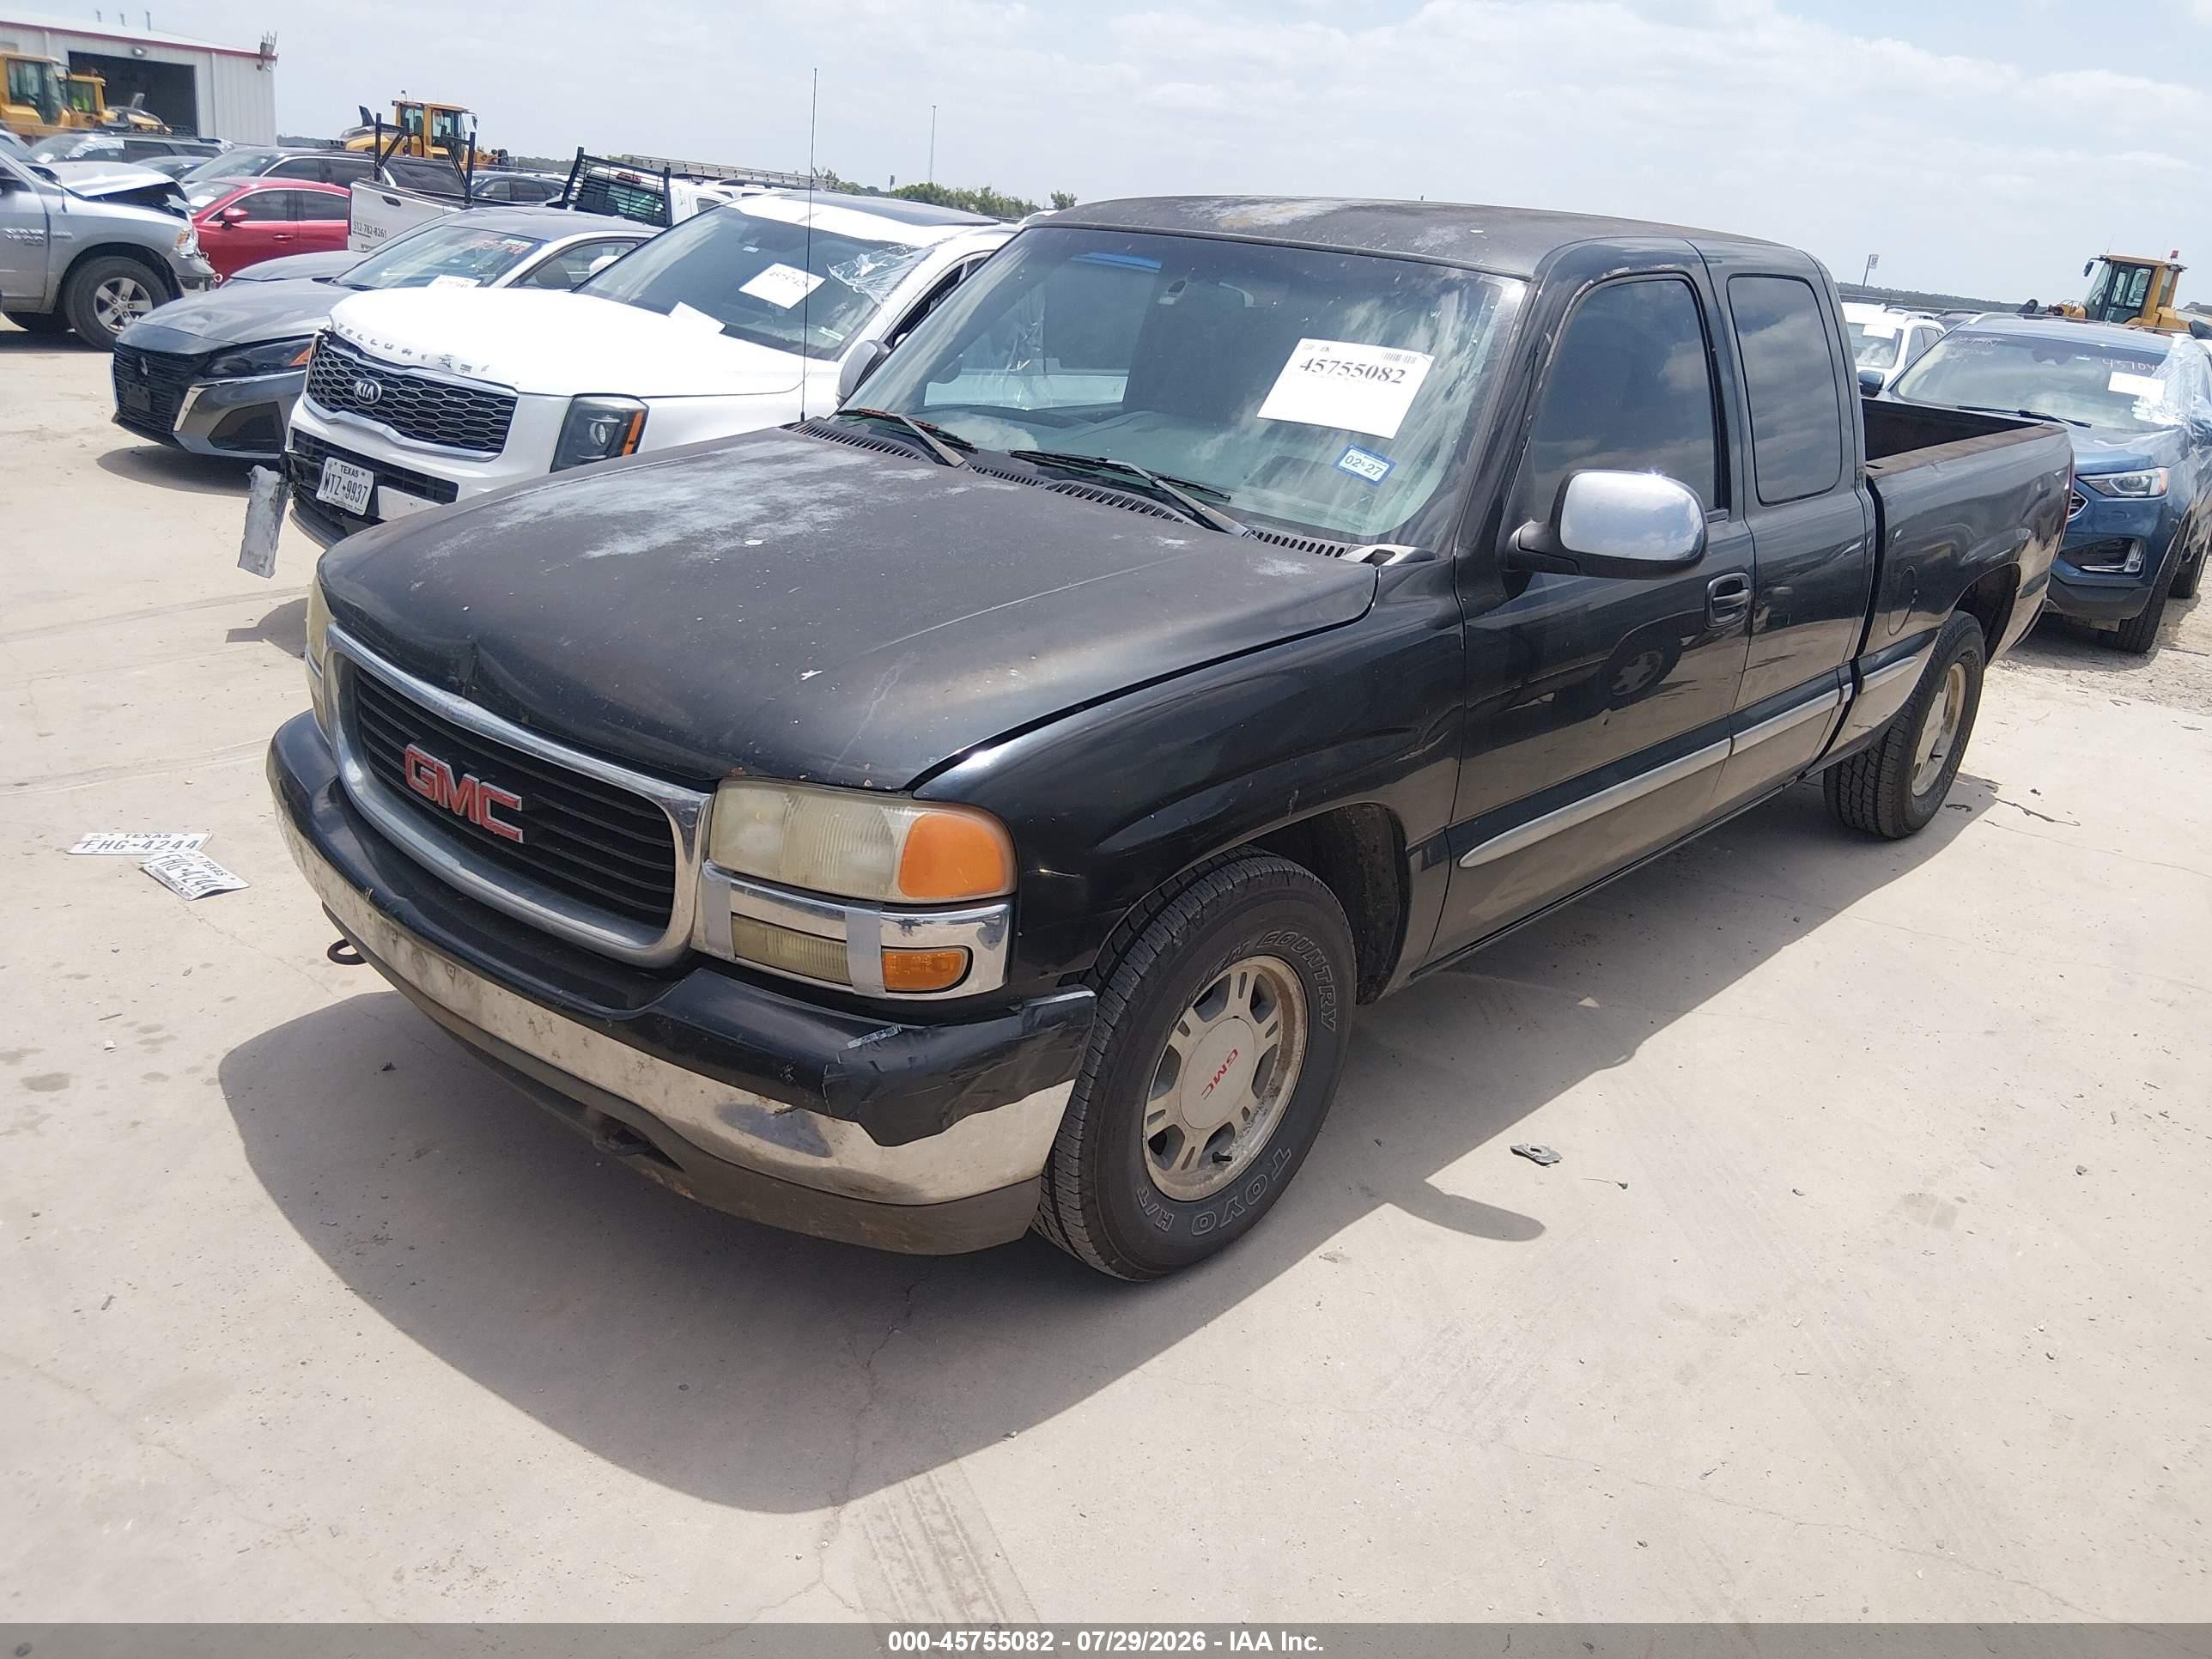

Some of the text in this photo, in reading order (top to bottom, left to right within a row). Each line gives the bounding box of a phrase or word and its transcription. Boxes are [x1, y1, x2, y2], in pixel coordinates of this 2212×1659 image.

[1299, 356, 1407, 385] 45755082
[356, 381, 374, 400] KIA
[340, 465, 360, 478] TEXAS
[1345, 454, 1383, 476] 02 27
[404, 743, 524, 843] GMC
[199, 860, 228, 877] TEXAS
[1256, 931, 1337, 1032] COUNTRY
[1201, 1048, 1238, 1100] GMC
[1136, 1146, 1292, 1236] TOYO H/T
